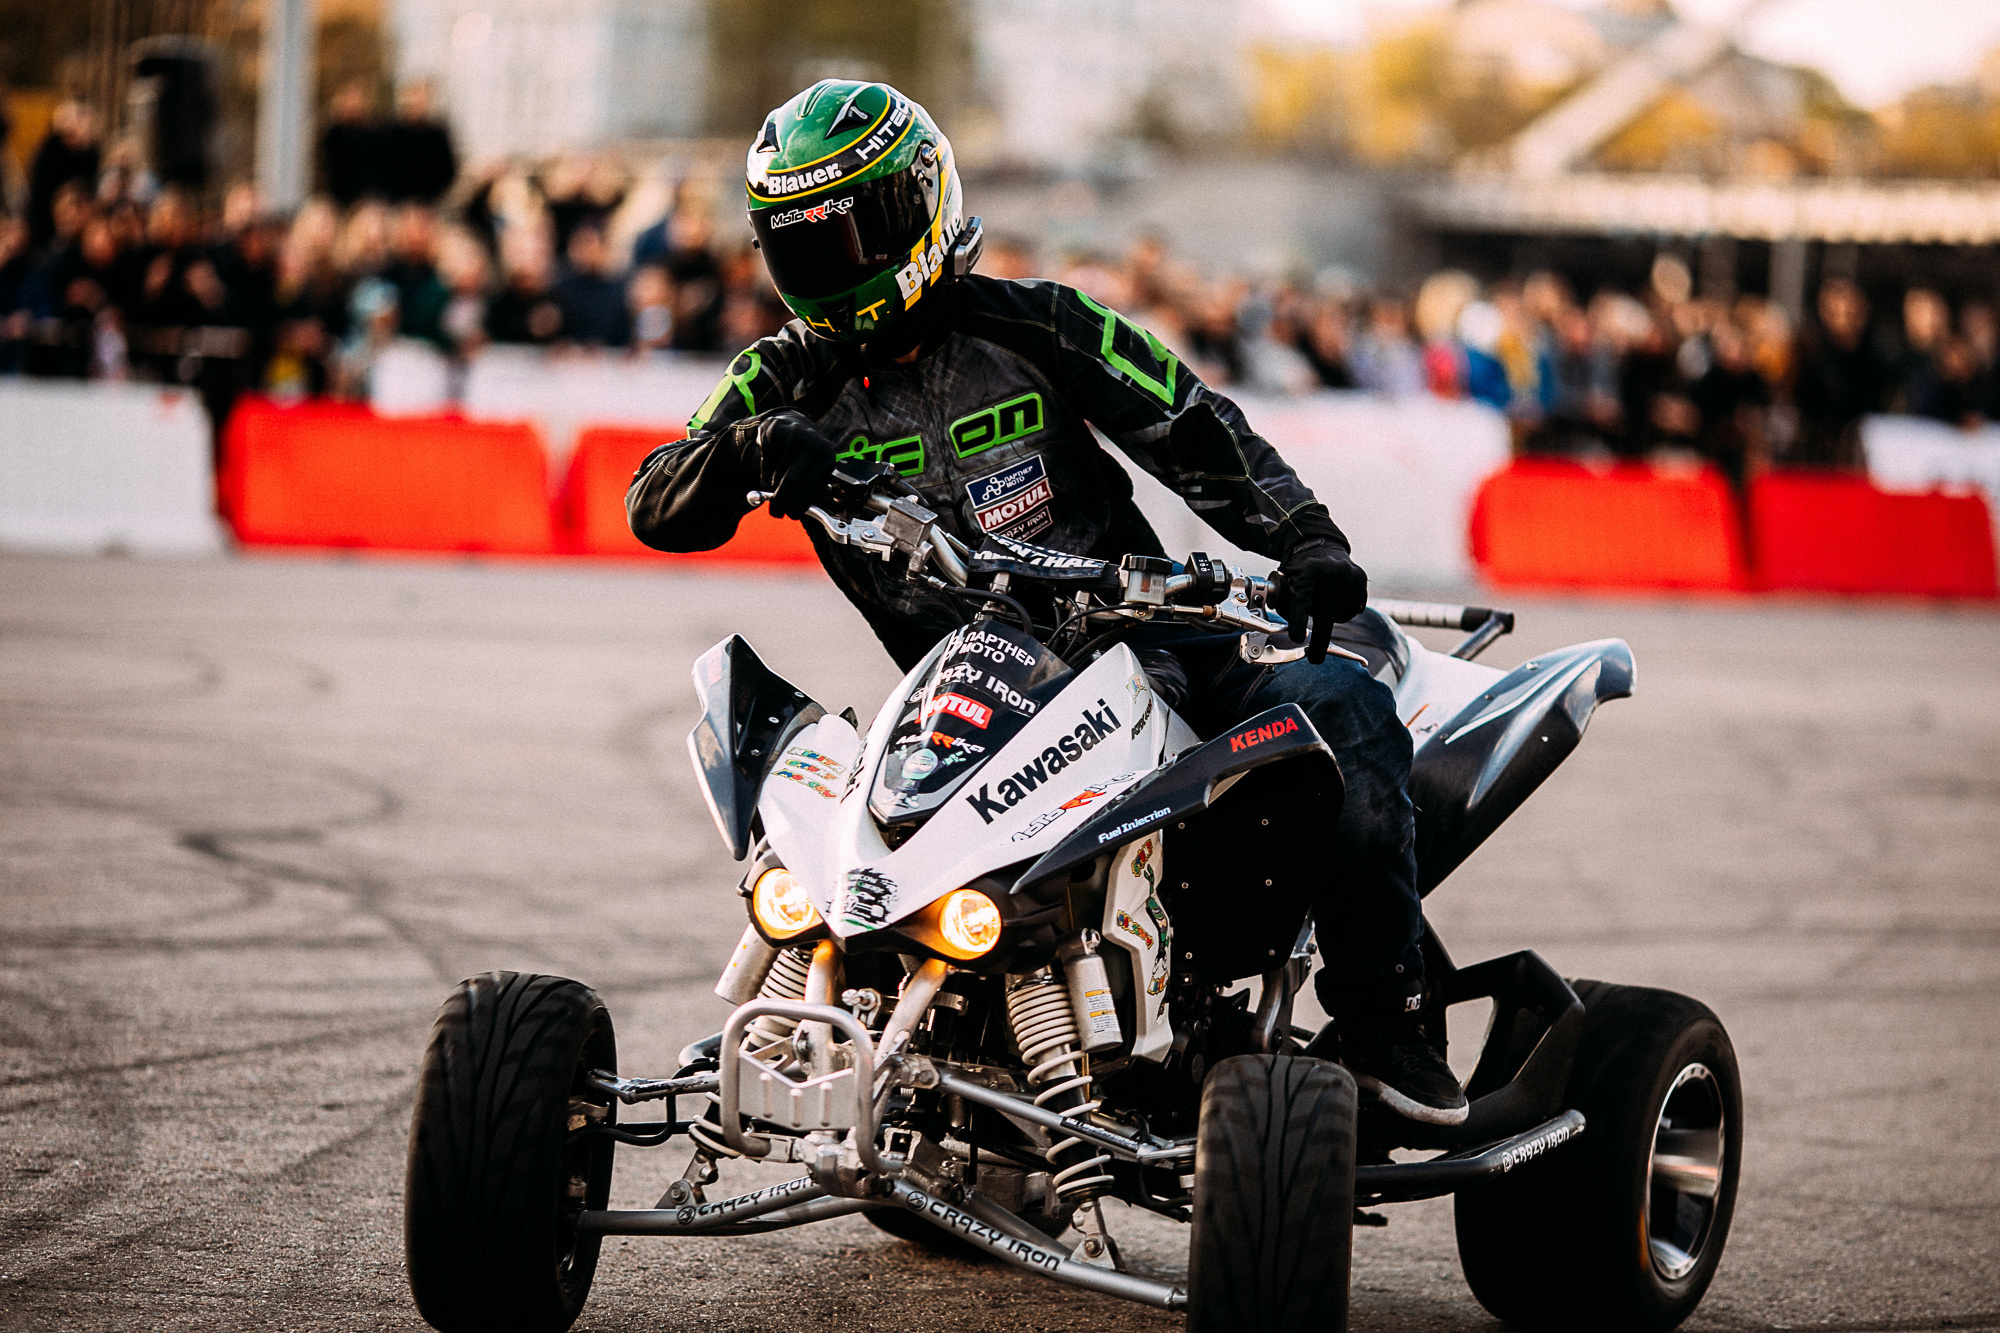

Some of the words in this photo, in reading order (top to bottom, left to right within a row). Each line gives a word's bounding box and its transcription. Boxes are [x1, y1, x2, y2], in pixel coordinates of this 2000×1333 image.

[895, 210, 961, 300] Blaue
[984, 485, 1047, 529] MOTUL
[992, 535, 1101, 568] ENTHAL
[965, 630, 1036, 667] ПАРТНЕР
[985, 675, 1037, 713] IRON
[1230, 717, 1299, 752] KENDA
[966, 698, 1121, 825] Kawasaki
[1098, 826, 1122, 844] Fuel
[1511, 1136, 1546, 1163] CRAZY
[1546, 1126, 1570, 1149] IRON
[698, 1190, 763, 1215] CRAZY
[929, 1201, 1004, 1245] CRAZY
[1007, 1239, 1060, 1271] IRON
